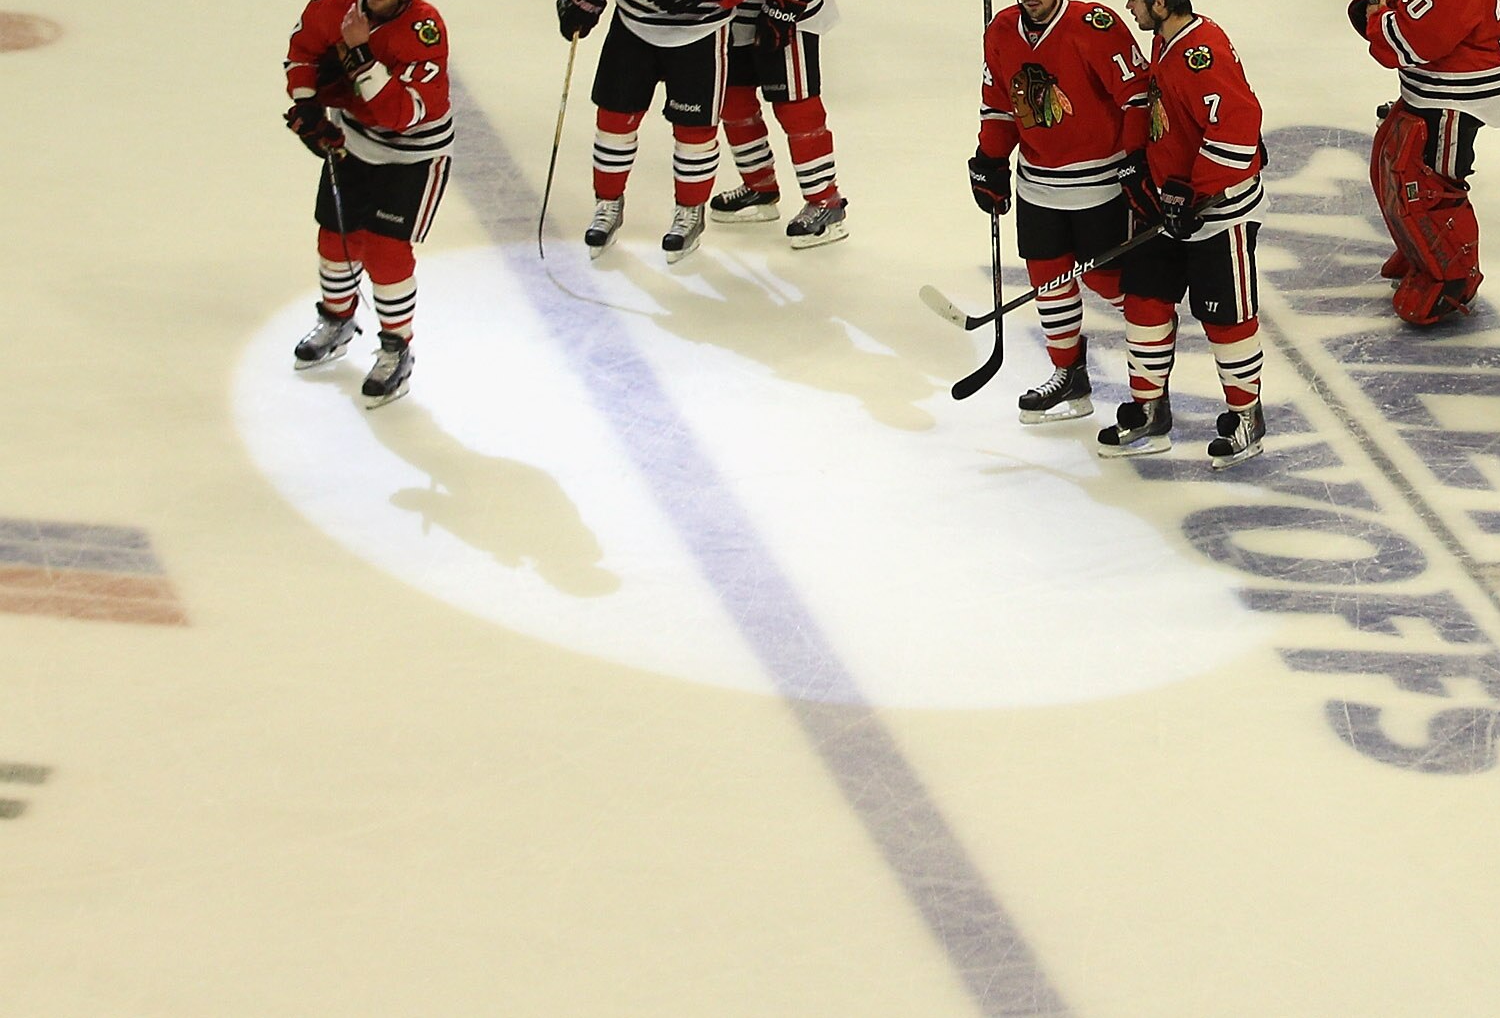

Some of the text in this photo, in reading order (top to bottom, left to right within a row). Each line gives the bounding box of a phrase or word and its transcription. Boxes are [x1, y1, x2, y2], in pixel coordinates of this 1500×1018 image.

[399, 60, 440, 84] 17
[1112, 44, 1149, 82] 14
[669, 98, 702, 113] Reebok
[1203, 94, 1220, 123] 7
